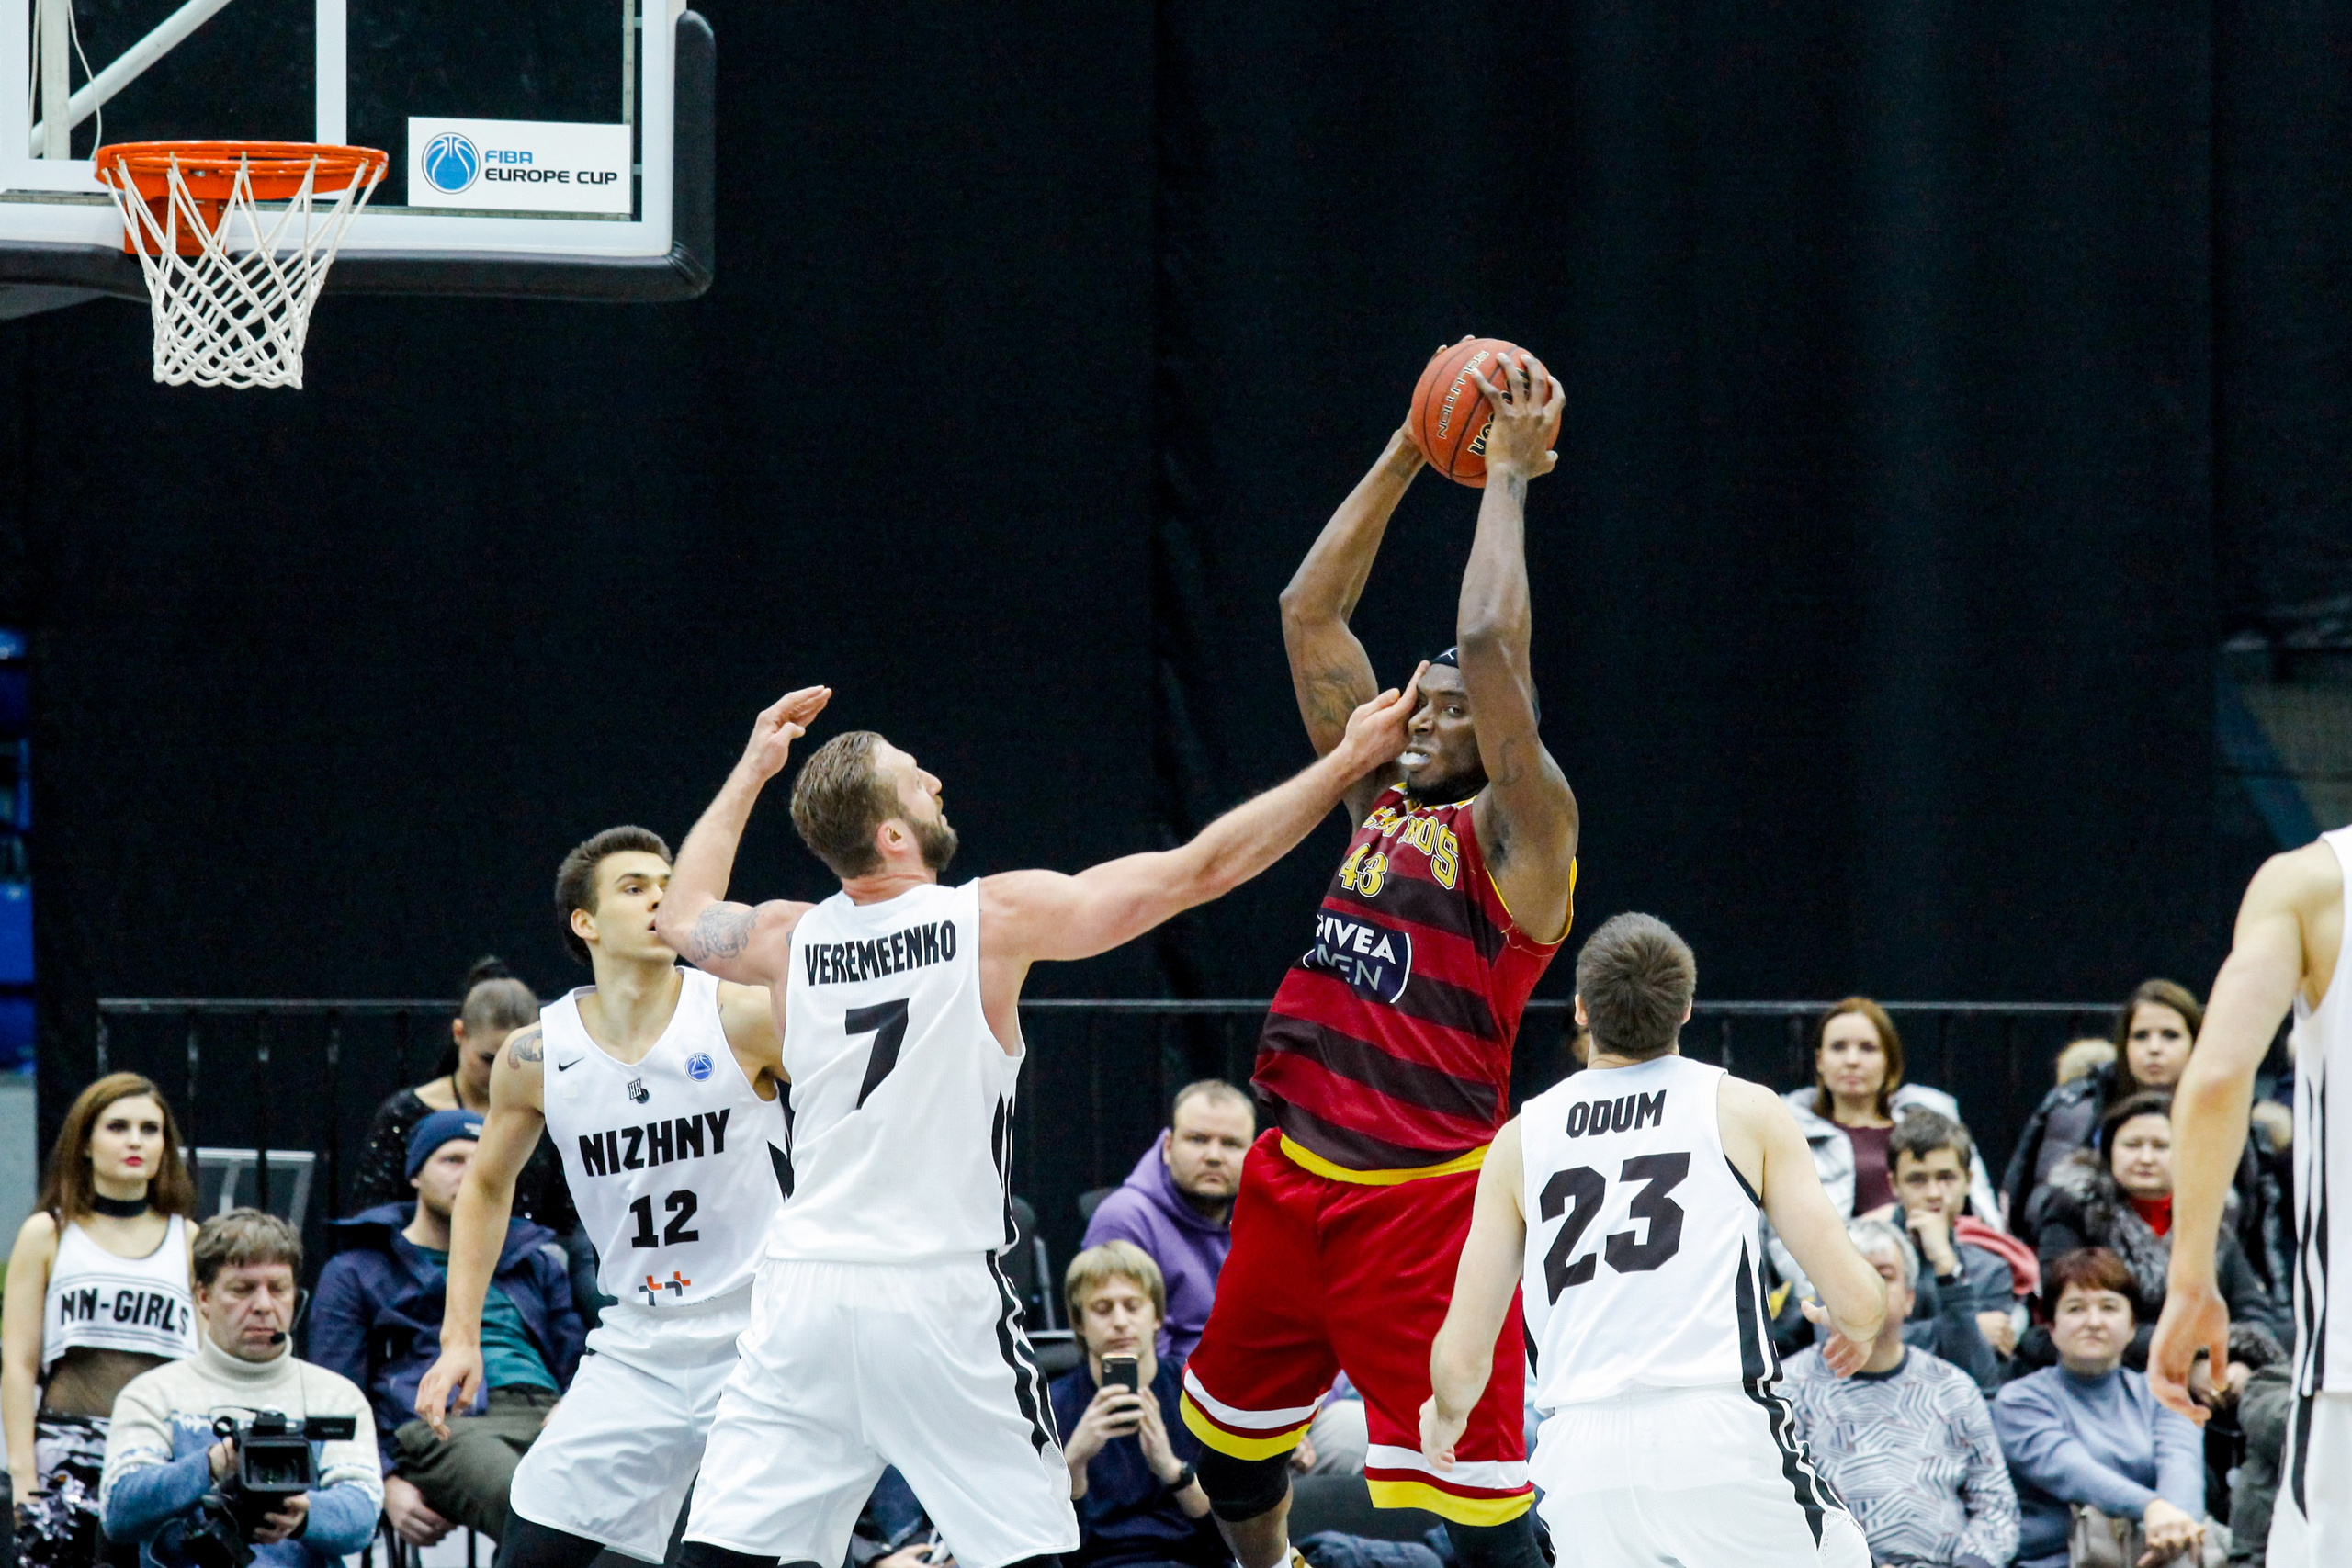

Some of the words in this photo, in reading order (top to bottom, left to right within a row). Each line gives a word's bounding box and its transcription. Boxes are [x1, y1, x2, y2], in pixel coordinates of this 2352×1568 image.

[485, 150, 533, 164] FIBA
[485, 168, 570, 183] EUROPE
[577, 171, 617, 185] CUP
[1437, 350, 1489, 439] SOLUTION
[1339, 843, 1389, 897] 43
[805, 919, 956, 987] VEREMEENKO
[844, 998, 910, 1110] 7
[578, 1108, 731, 1177] NIZHNY
[1566, 1089, 1667, 1138] ODUM
[629, 1189, 699, 1248] 12
[1539, 1151, 1691, 1306] 23
[61, 1288, 188, 1336] NN-GIRLS
